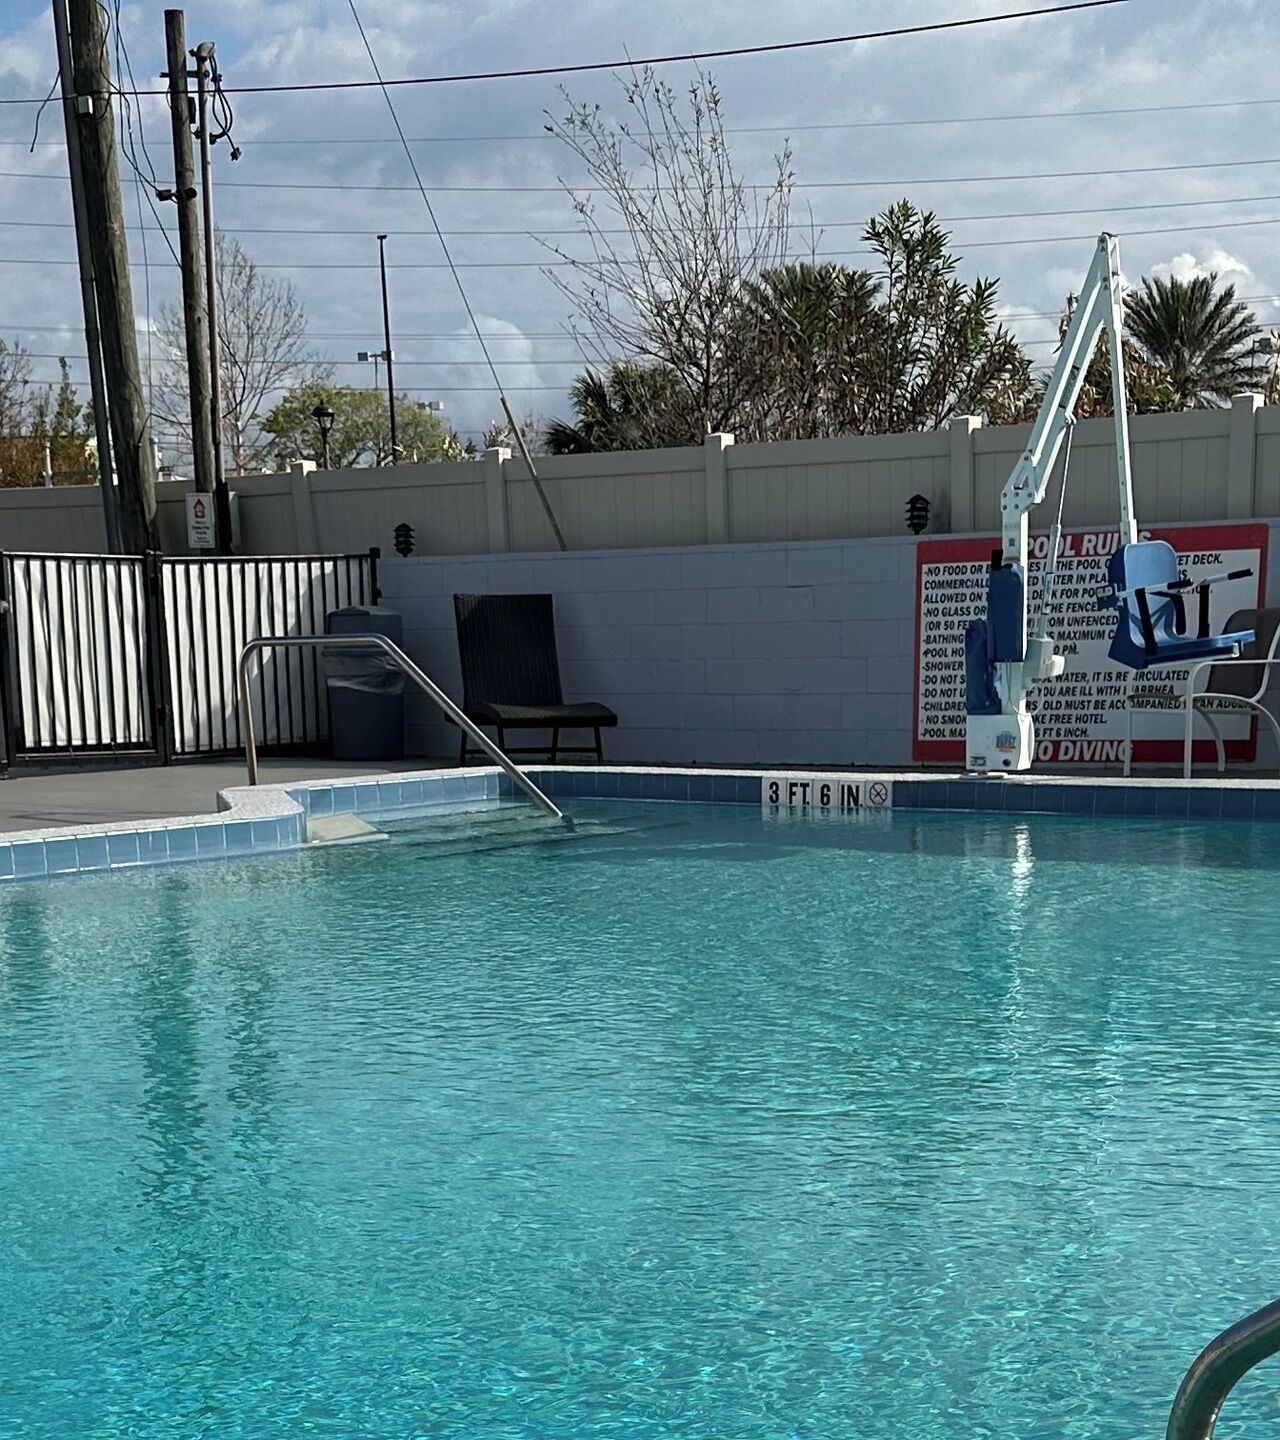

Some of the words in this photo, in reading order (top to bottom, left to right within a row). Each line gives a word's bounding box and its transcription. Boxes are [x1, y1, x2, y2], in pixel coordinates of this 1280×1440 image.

[942, 564, 968, 576] FOOD
[970, 564, 983, 575] OR
[1056, 560, 1074, 571] THE
[1076, 558, 1101, 570] POOL
[1192, 553, 1223, 565] DECK.
[924, 577, 990, 590] COMMERCIALL
[1076, 573, 1087, 584] IN
[924, 592, 967, 604] ALLOWED
[969, 591, 983, 602] ON
[1060, 589, 1080, 600] FOR
[941, 604, 970, 617] GLASS
[973, 604, 987, 616] OR
[925, 620, 941, 631] (OR
[943, 619, 955, 630] 50
[1067, 615, 1118, 627] UNFENCED
[1057, 630, 1107, 641] MAXIMUM
[940, 674, 959, 684] NOT
[1091, 672, 1101, 683] IT
[1103, 671, 1113, 682] IS
[940, 687, 958, 698] NOT
[1037, 686, 1057, 697] YOU
[1057, 686, 1078, 697] ARE
[1079, 686, 1093, 697] ILL
[1096, 685, 1121, 696] WITH
[1043, 700, 1062, 710] OLD
[1064, 700, 1091, 710] MUST
[1093, 699, 1107, 710] BE
[926, 714, 939, 725] NO
[1048, 713, 1073, 724] FREE
[1075, 713, 1107, 724] HOTEL.
[1042, 728, 1053, 738] FT
[1055, 727, 1062, 737] 6
[1063, 727, 1090, 738] INCH.
[1057, 740, 1134, 761] DIVING
[769, 781, 780, 804] 3
[788, 782, 810, 806] FT.
[820, 783, 831, 806] 6
[841, 784, 864, 807] IN.
